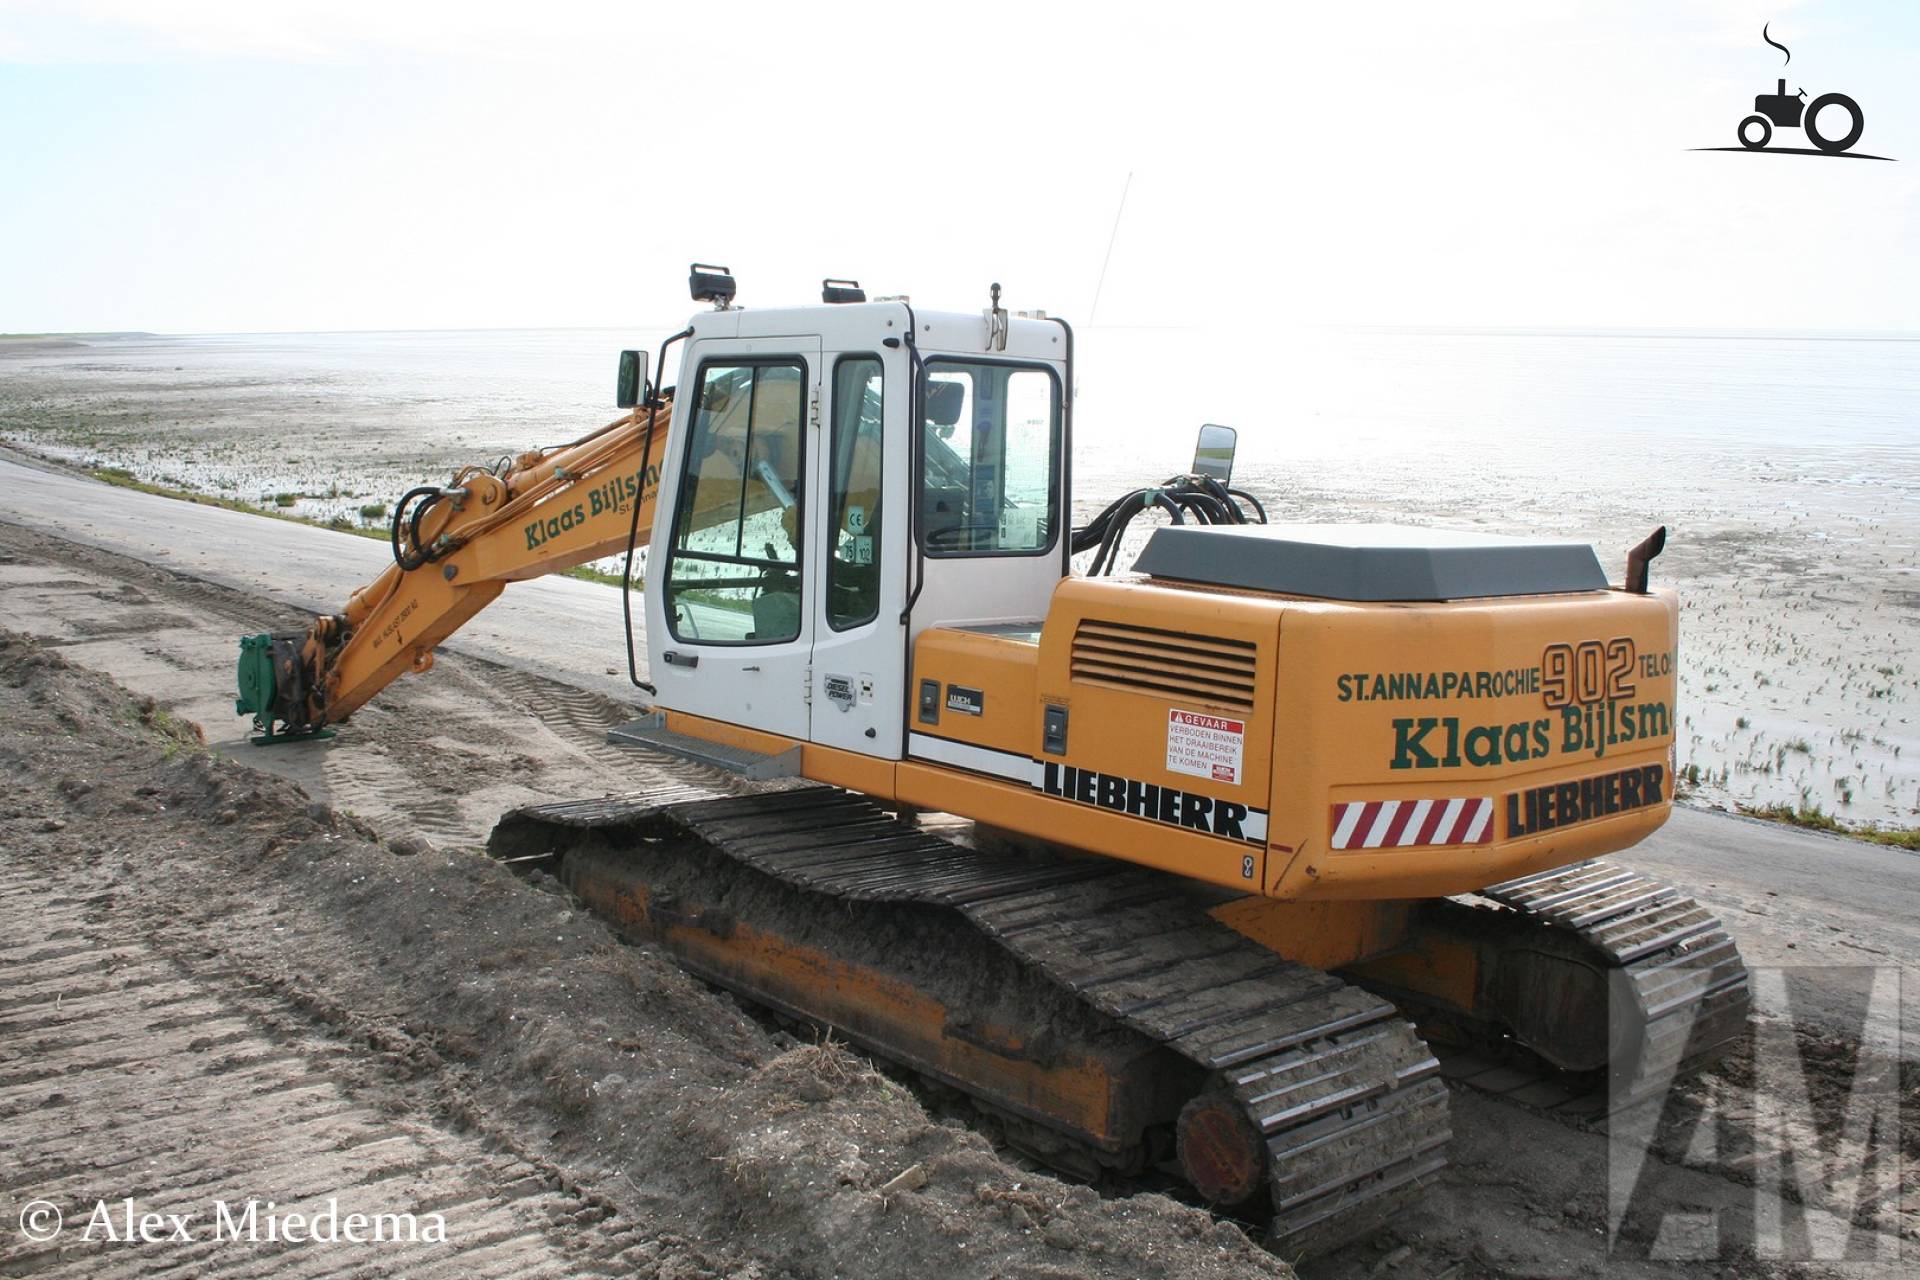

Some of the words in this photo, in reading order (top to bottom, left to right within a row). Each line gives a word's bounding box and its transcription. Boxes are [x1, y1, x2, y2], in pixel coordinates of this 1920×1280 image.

[524, 503, 586, 551] Klaas
[588, 459, 664, 518] Bijlsm
[849, 513, 862, 526] CE
[1542, 637, 1636, 710] 902
[1337, 667, 1540, 702] ST.ANNAPAROCHIE
[828, 691, 853, 701] POWER
[1184, 714, 1228, 730] GEVAAR
[1169, 725, 1211, 741] VERBODEN
[1213, 732, 1243, 745] BINNEN
[1169, 735, 1184, 744] HET
[1185, 738, 1237, 755] DRAAIBEREIK
[1389, 717, 1550, 770] Klaas
[1561, 700, 1673, 758] Bijlsm
[1168, 755, 1178, 764] TE
[1179, 757, 1208, 769] KOMEN
[1169, 745, 1184, 754] VAN
[1185, 748, 1196, 757] DE
[1197, 751, 1234, 765] MACHINE
[1044, 761, 1247, 841] LIEBHERR
[1507, 764, 1664, 839] LIEBHERR
